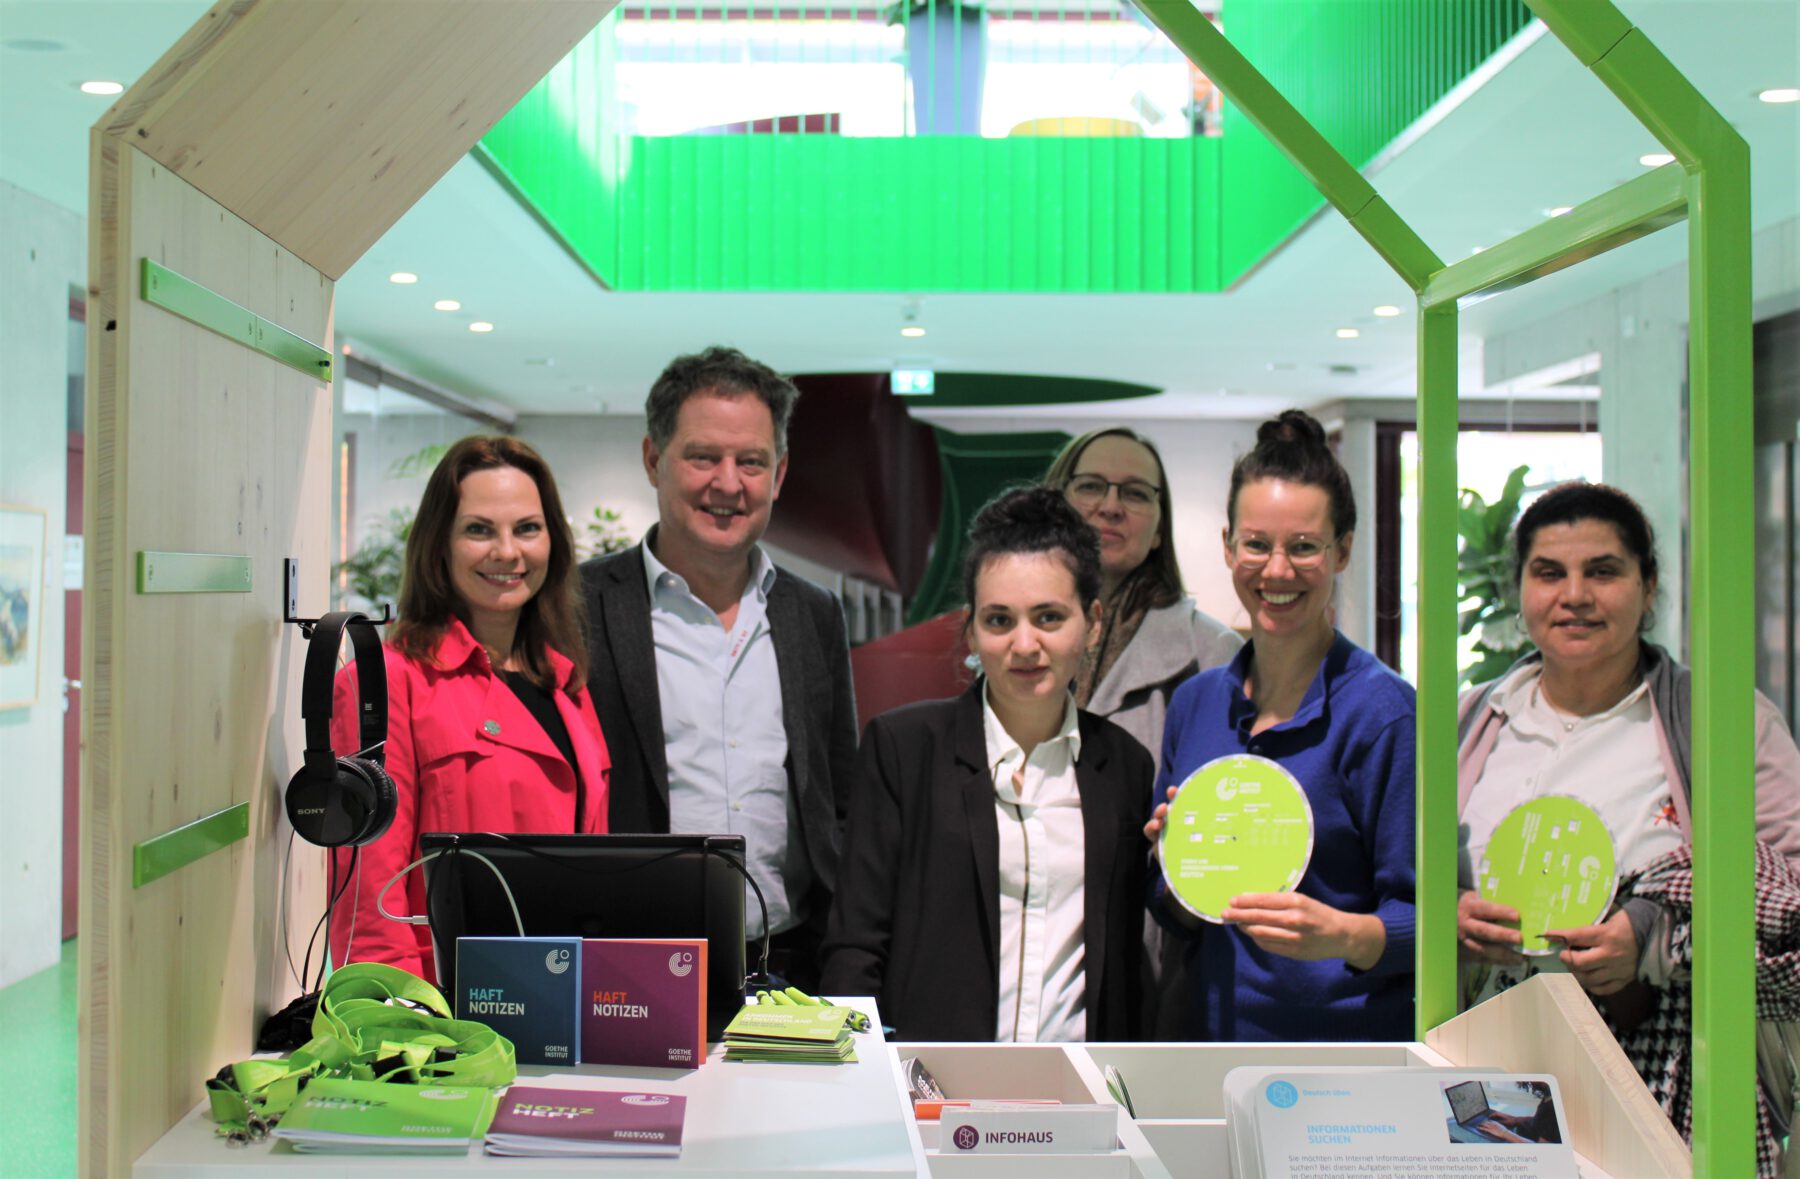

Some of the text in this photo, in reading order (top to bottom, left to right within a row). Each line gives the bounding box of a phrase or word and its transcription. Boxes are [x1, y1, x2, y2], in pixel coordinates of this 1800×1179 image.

[470, 988, 504, 1001] HAFT
[593, 991, 627, 1004] HAFT
[469, 1002, 525, 1016] NOTIZEN
[593, 1004, 648, 1018] NOTIZEN
[304, 1101, 368, 1112] HEFT
[309, 1096, 388, 1107] NOTIZ
[512, 1108, 580, 1119] HEFT
[514, 1103, 595, 1114] NOTIZ
[1307, 1125, 1397, 1134] INFORMATIONEN
[986, 1132, 1053, 1144] INFOHAUS
[1308, 1136, 1351, 1144] SUCHEN
[1358, 1164, 1391, 1172] Aufgaben
